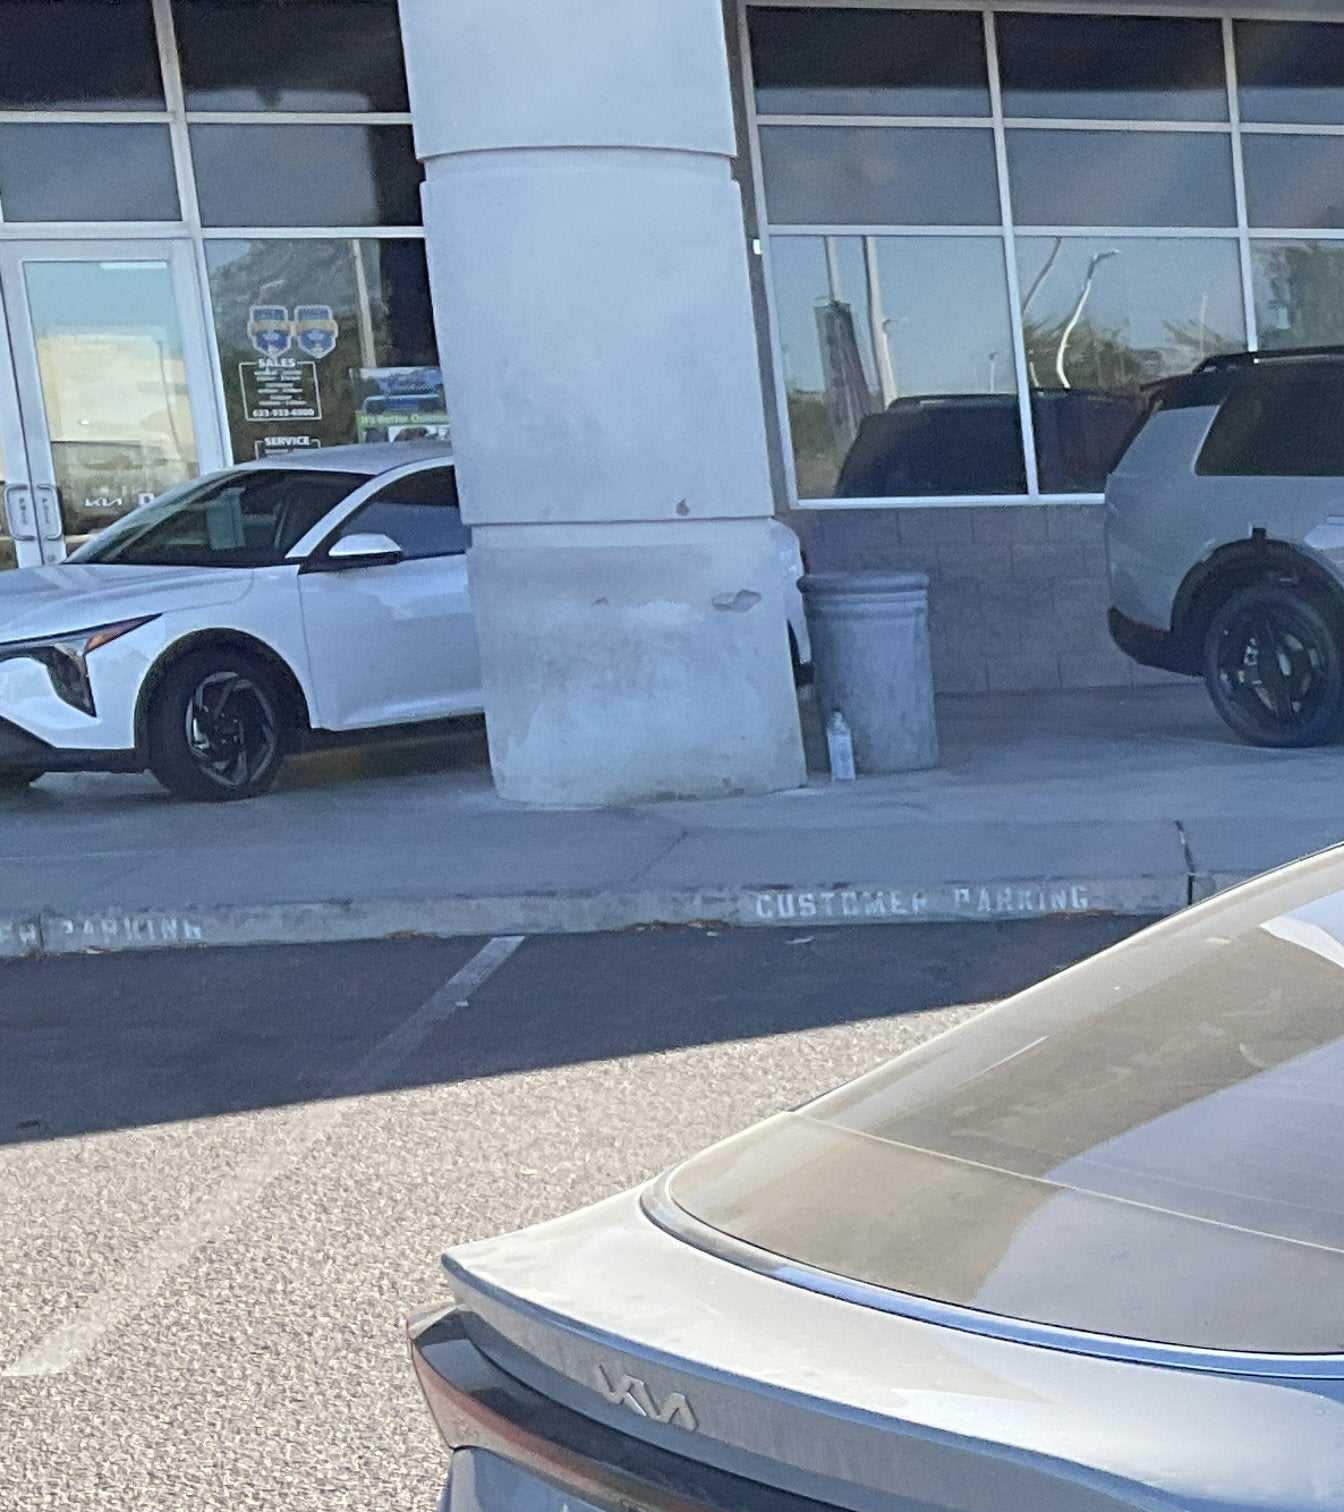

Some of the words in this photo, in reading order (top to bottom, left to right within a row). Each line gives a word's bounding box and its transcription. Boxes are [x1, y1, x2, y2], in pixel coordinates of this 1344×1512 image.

[258, 358, 296, 367] SALES
[264, 436, 310, 446] SERVICE
[755, 890, 927, 918] CUSTOMER
[953, 885, 1089, 912] PARKING
[598, 1363, 700, 1432] KIA
